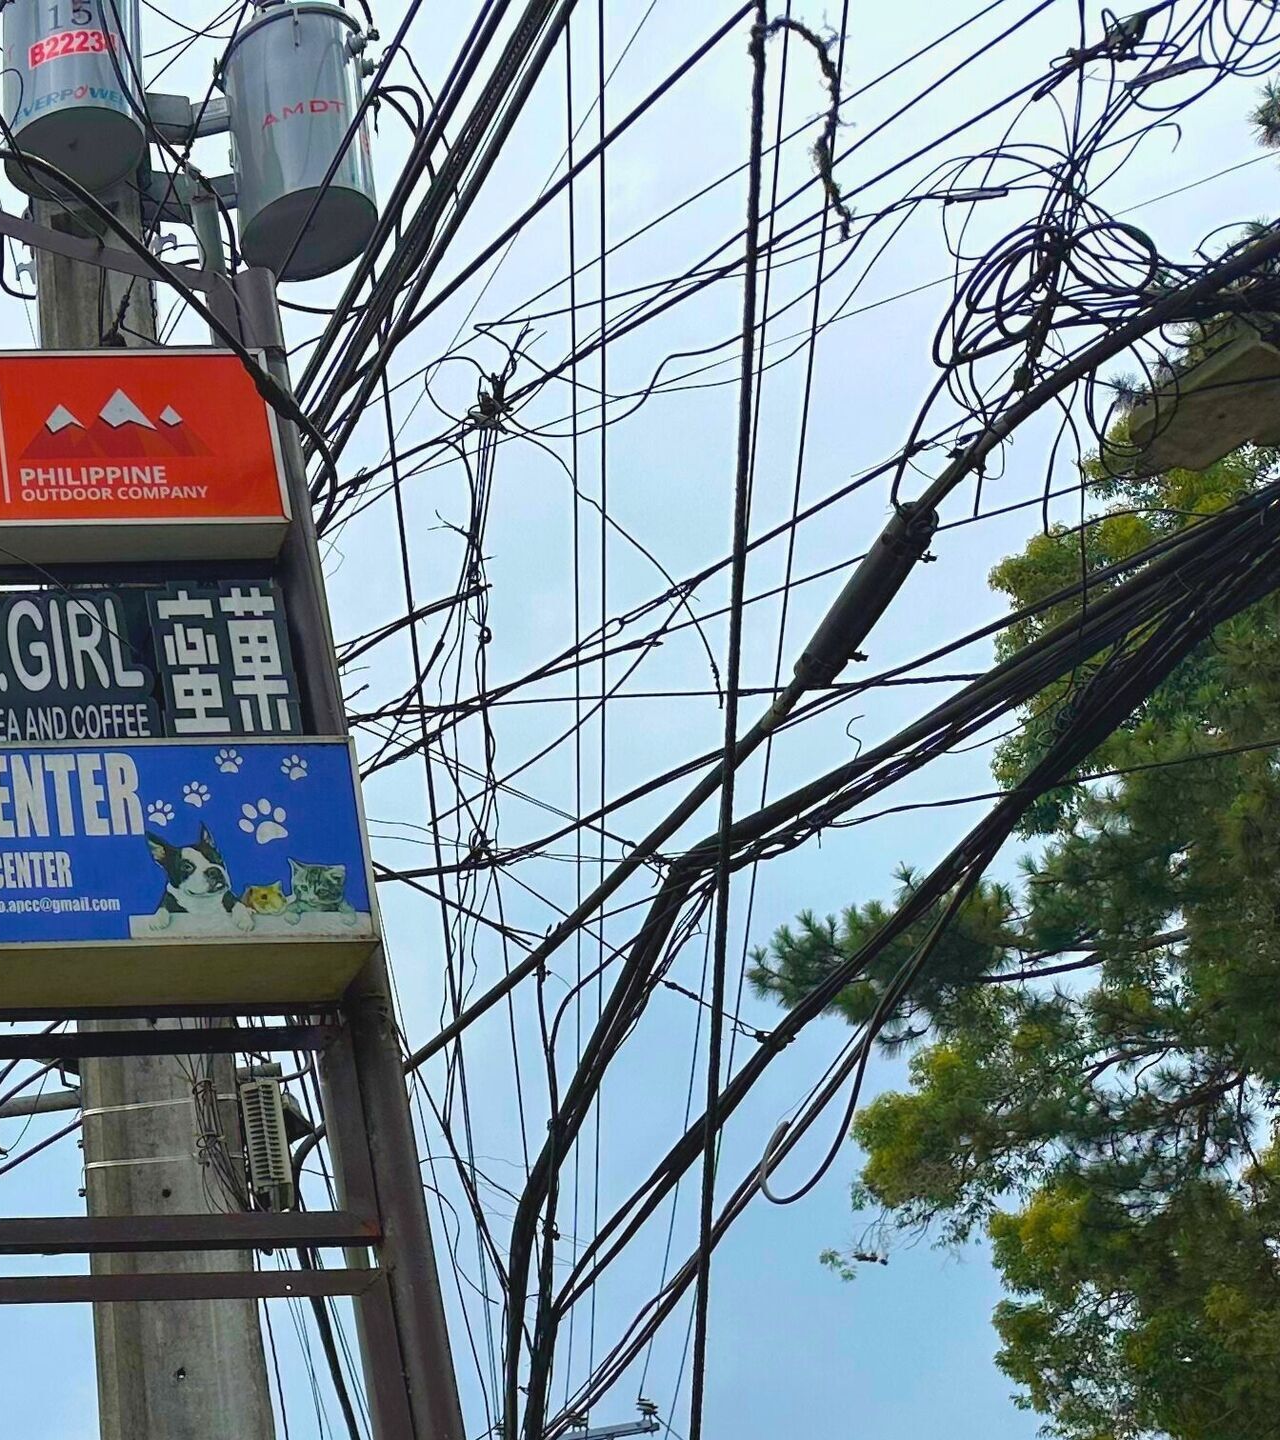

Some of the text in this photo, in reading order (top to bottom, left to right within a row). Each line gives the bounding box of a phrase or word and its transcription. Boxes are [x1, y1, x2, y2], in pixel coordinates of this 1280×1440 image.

[30, 31, 117, 67] B2223
[19, 465, 167, 486] PHILIPPINE
[21, 485, 208, 501] OUTDOOR COMPANY
[25, 706, 67, 740] AND
[71, 703, 151, 738] COFFEE
